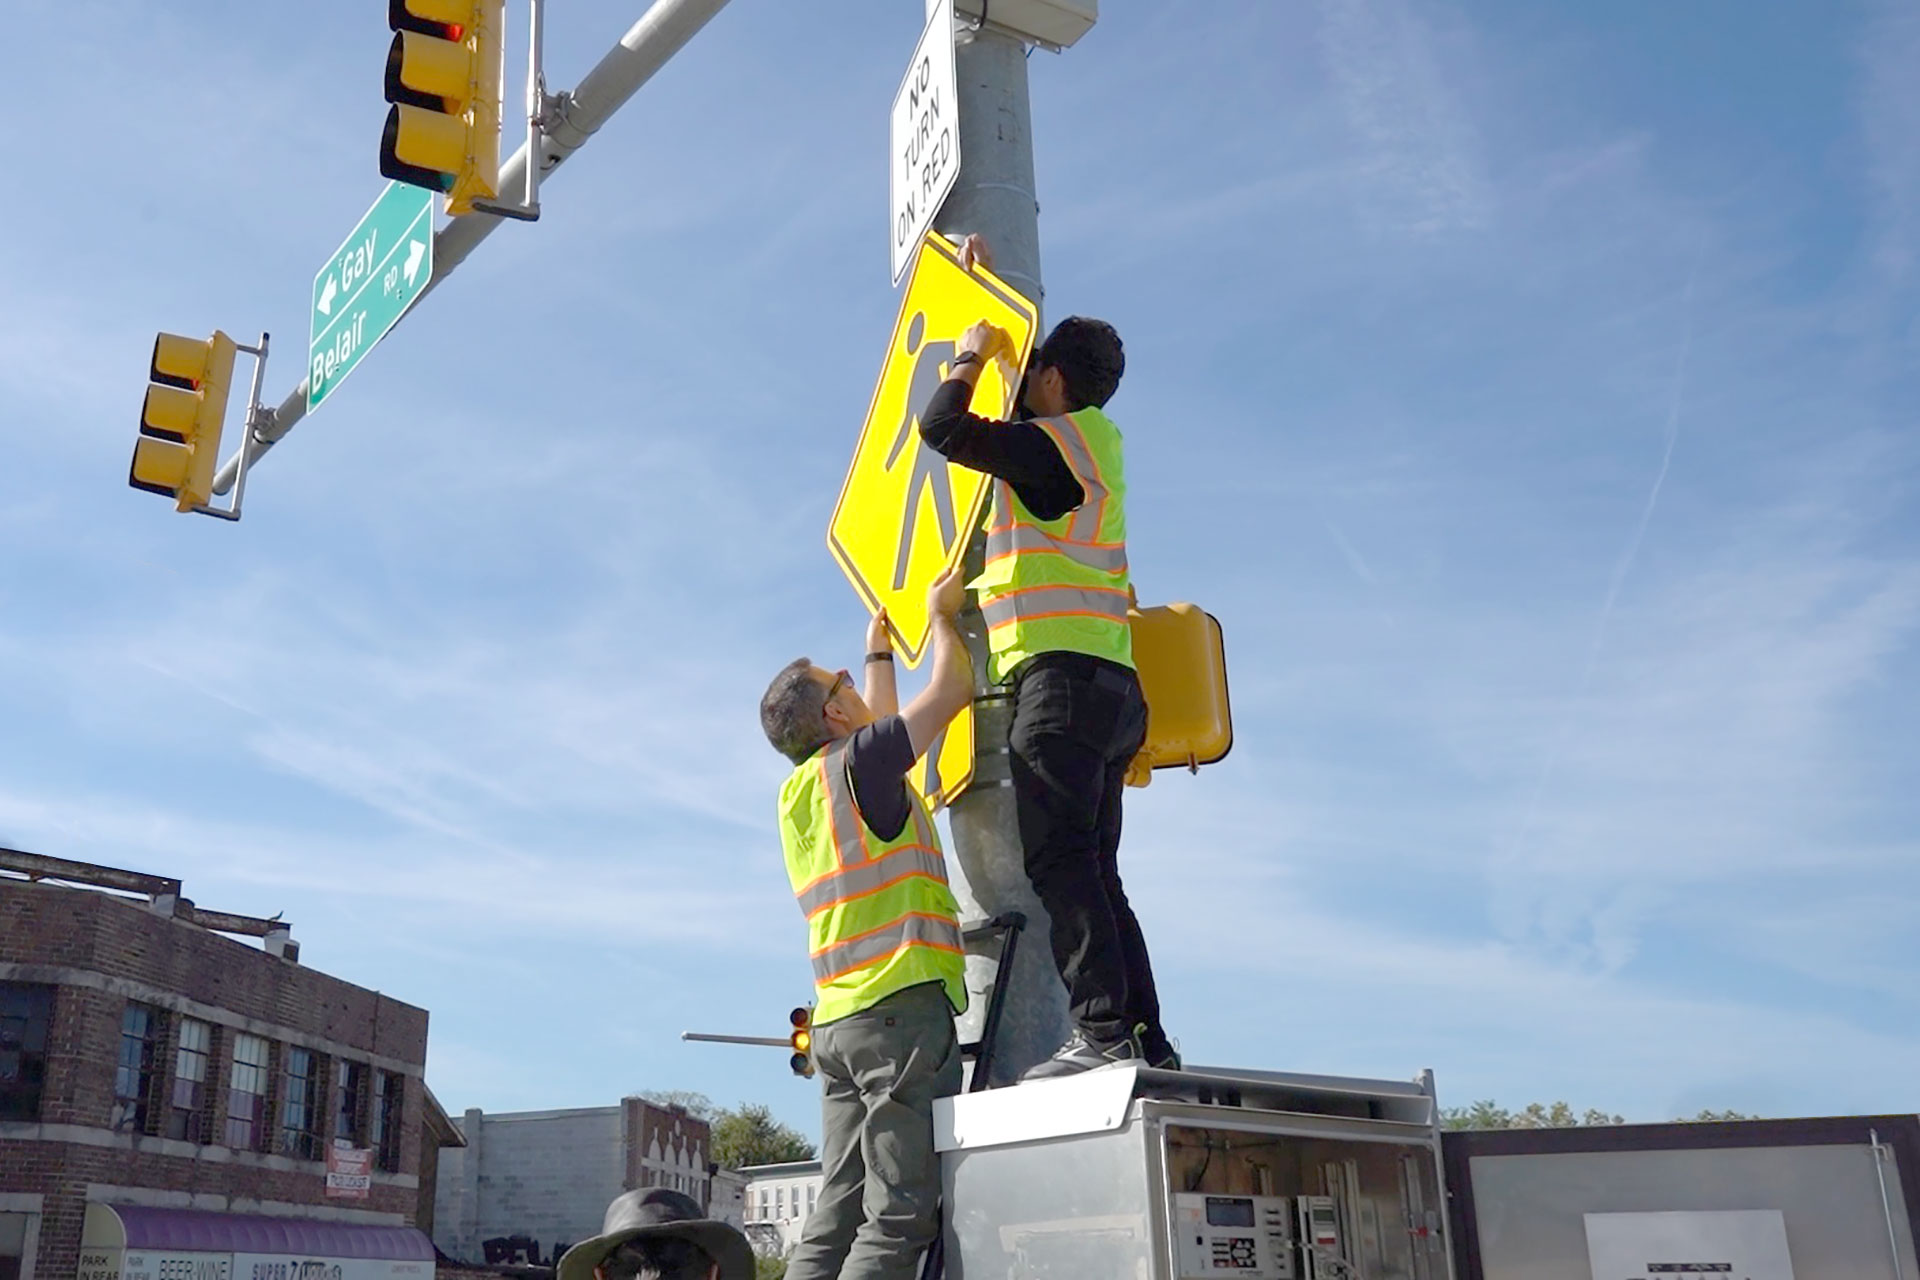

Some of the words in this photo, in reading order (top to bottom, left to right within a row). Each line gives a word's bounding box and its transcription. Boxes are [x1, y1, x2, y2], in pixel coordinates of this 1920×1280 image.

[910, 56, 930, 121] NO
[904, 85, 940, 181] TURN
[898, 191, 915, 248] ON
[922, 127, 950, 204] RED
[342, 228, 377, 291] Gay
[311, 310, 367, 394] Belair
[383, 265, 398, 296] RD
[81, 1255, 108, 1266] PARK
[252, 1263, 287, 1280] SUPER
